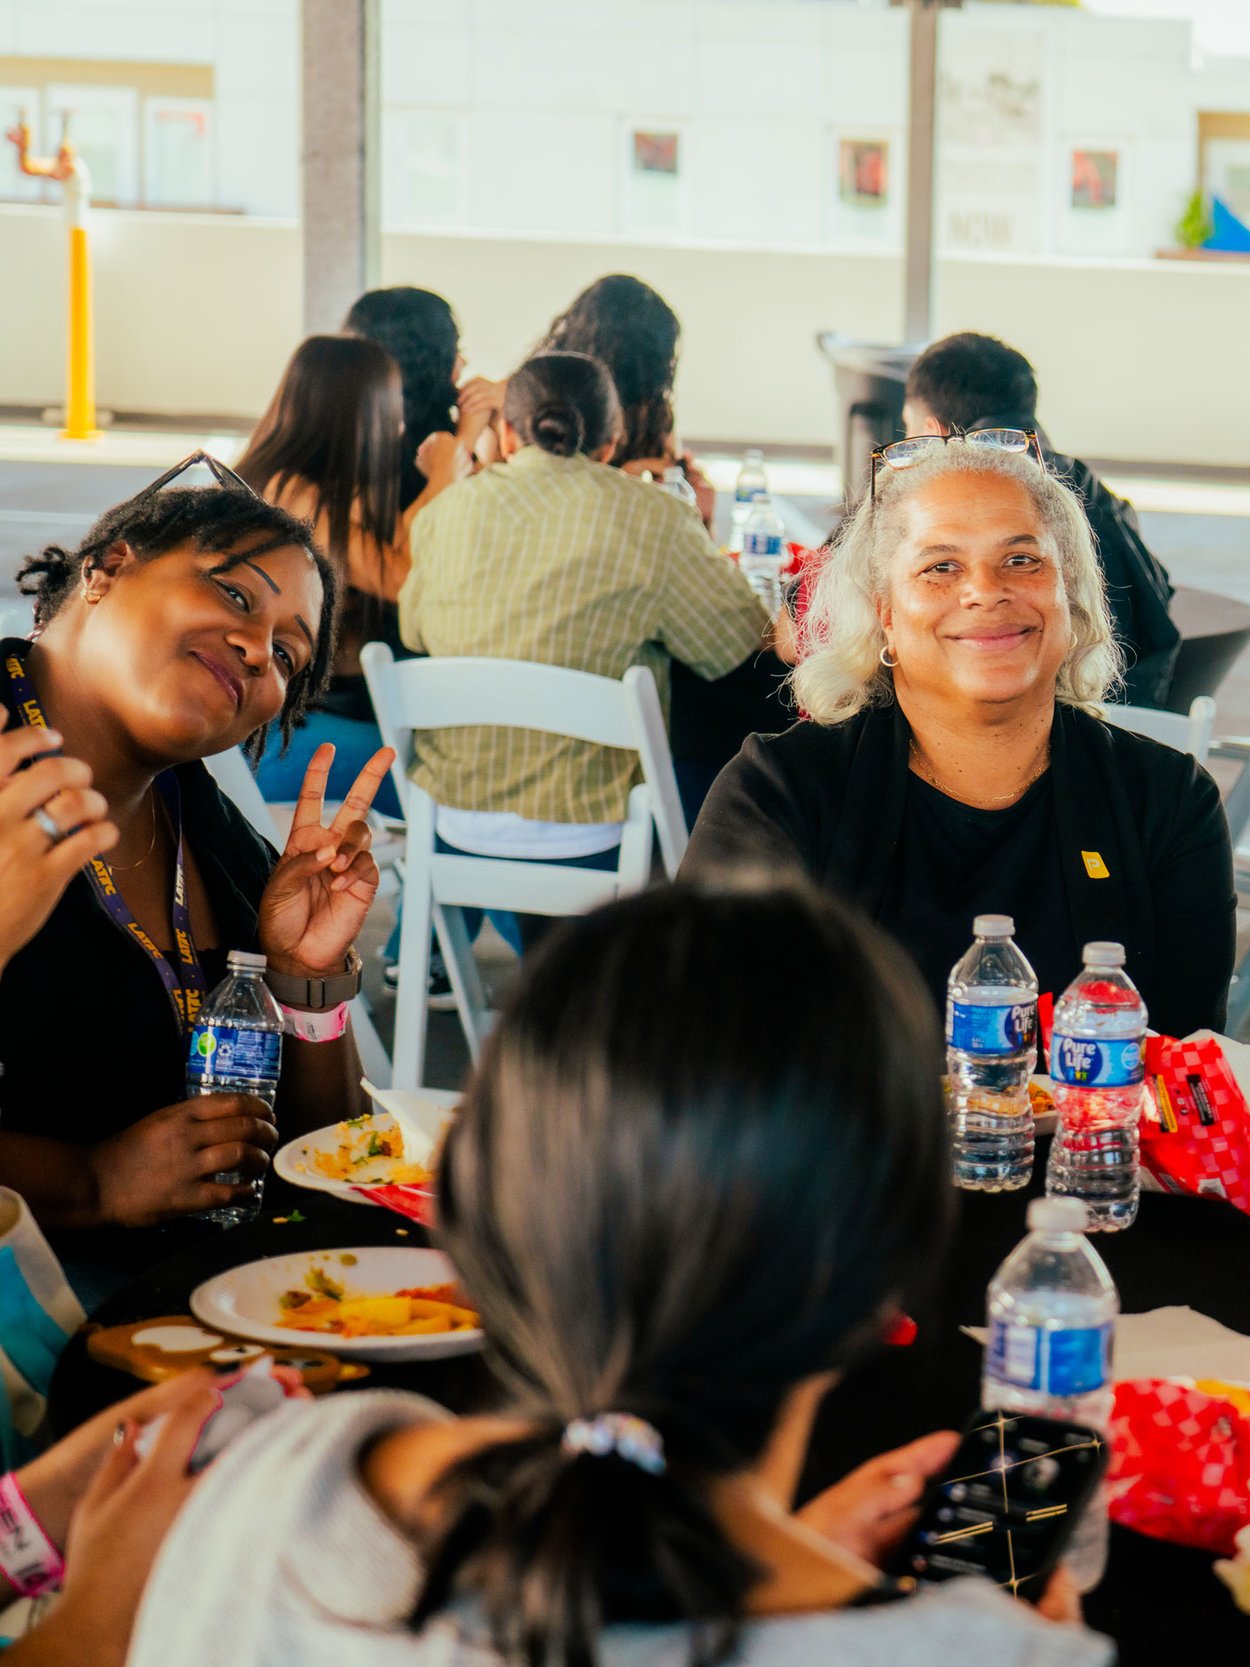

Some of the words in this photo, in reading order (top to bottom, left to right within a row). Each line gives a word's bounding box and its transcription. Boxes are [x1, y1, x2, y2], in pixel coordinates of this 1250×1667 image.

[1011, 1005, 1036, 1020] Pure
[1014, 1016, 1034, 1034] Life
[1062, 1038, 1096, 1056] Pure
[1065, 1051, 1092, 1071] Life
